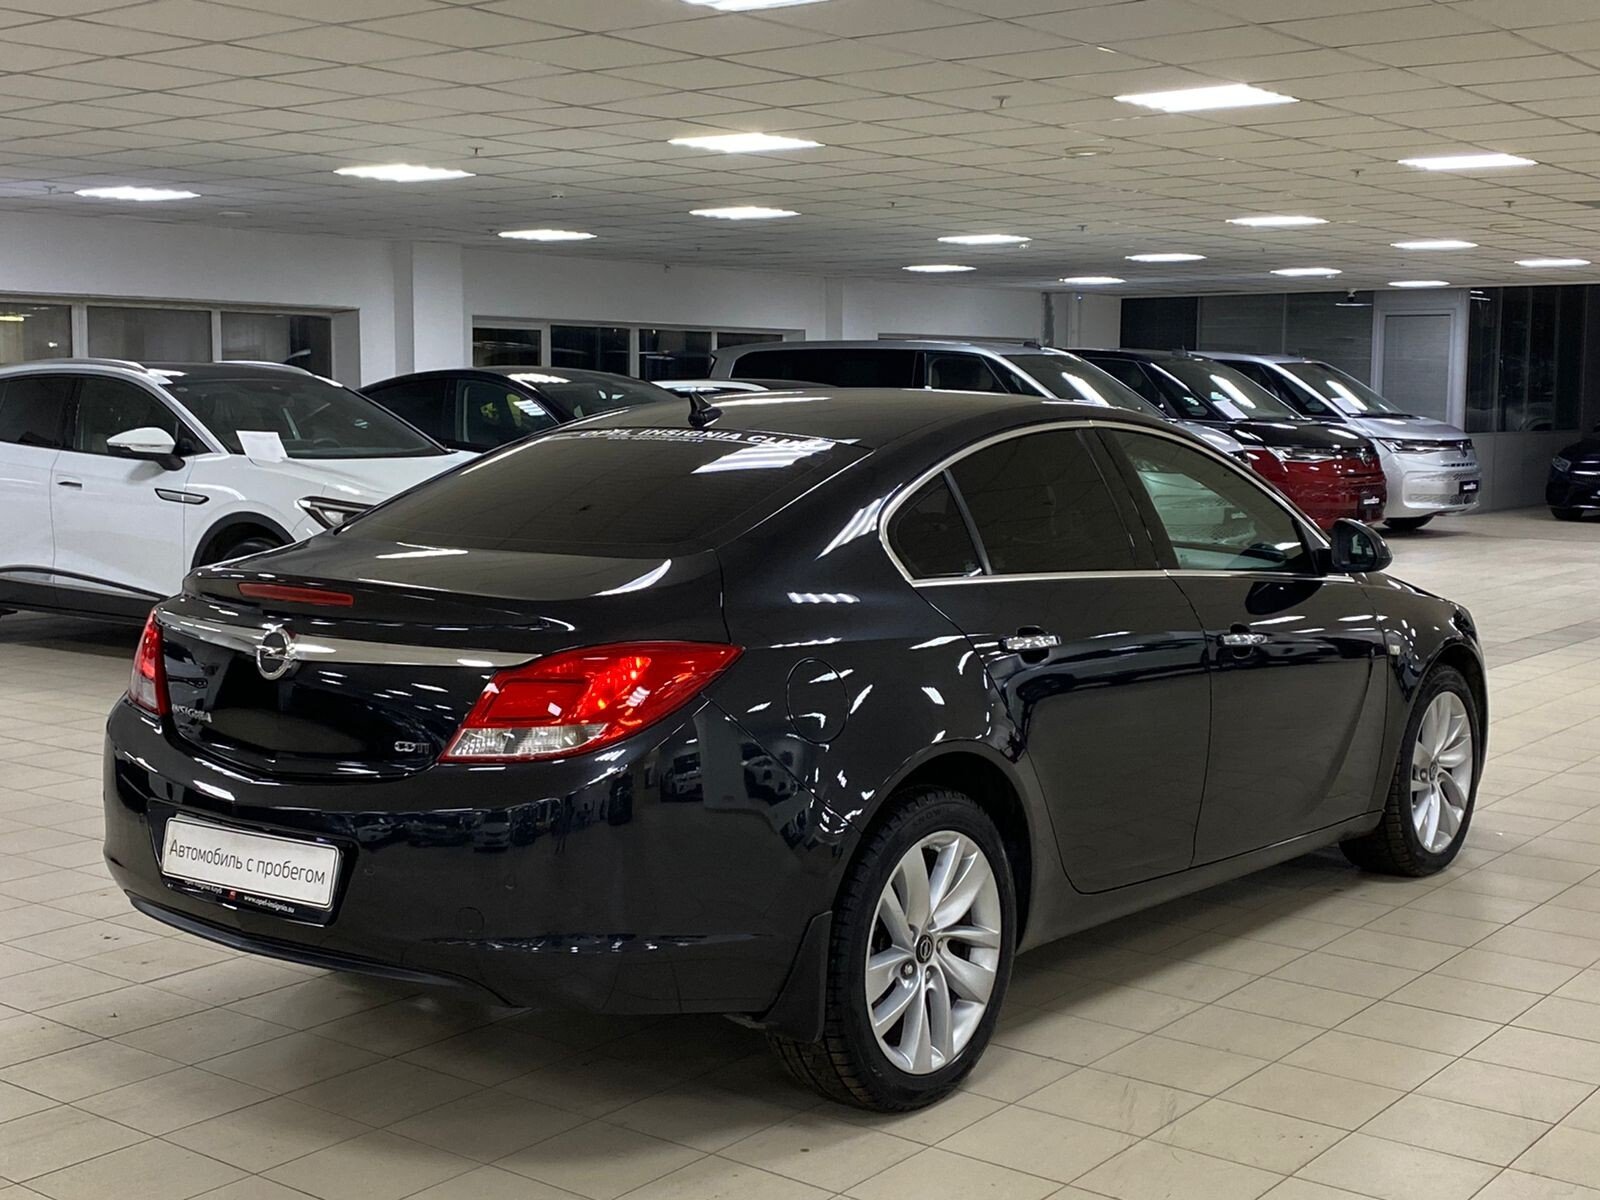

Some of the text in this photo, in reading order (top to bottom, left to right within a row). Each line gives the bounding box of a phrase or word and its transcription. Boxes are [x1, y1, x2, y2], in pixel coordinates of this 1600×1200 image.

[639, 428, 742, 442] INSIGNIA
[171, 703, 213, 724] INSIGNIA
[169, 839, 326, 885] Автомобиль с пробегом
